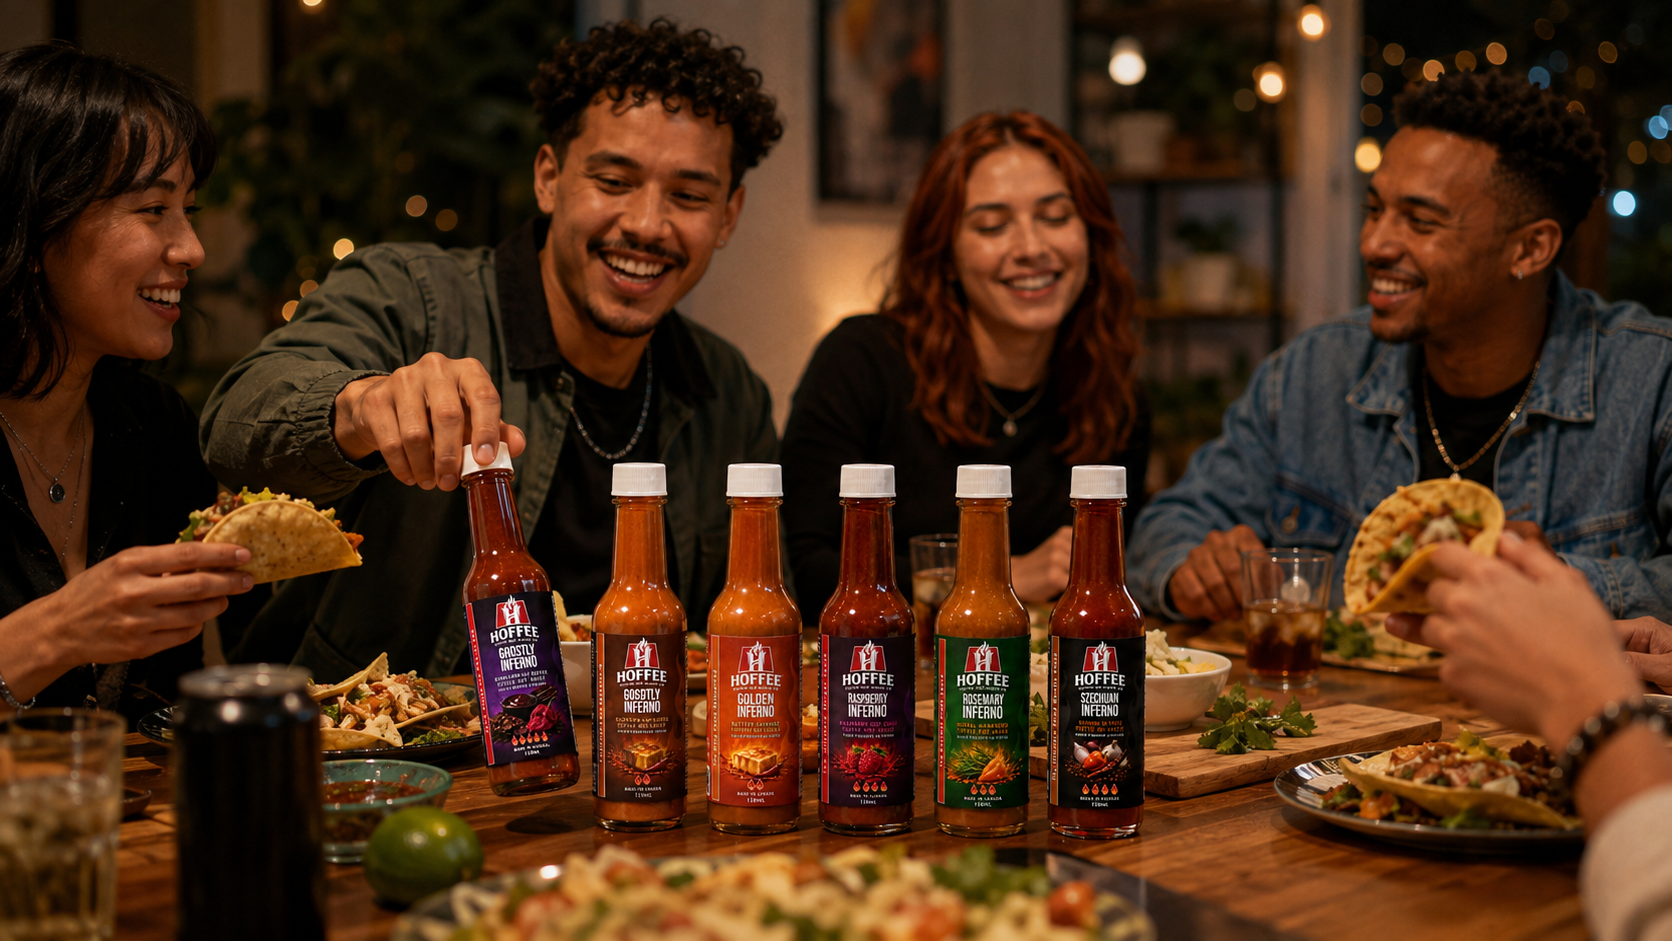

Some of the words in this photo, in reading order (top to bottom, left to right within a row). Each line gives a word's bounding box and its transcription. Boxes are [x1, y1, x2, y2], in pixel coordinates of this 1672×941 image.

[490, 625, 540, 644] HOFFEE
[500, 655, 538, 672] INFERNO
[617, 669, 667, 683] HOFFEE
[730, 673, 782, 687] HOFFEE
[842, 672, 894, 687] HOFFEE
[957, 673, 1009, 687] HOFFEE
[1074, 673, 1126, 687] HOFFEE
[737, 693, 775, 705] GOLDEN
[962, 693, 1005, 705] ROSEMARY
[624, 701, 661, 713] INFERNO
[737, 705, 775, 718] INFERNO
[848, 704, 887, 718] INFERNO
[962, 705, 1004, 719] INFERNO
[1081, 704, 1119, 717] INFERNO
